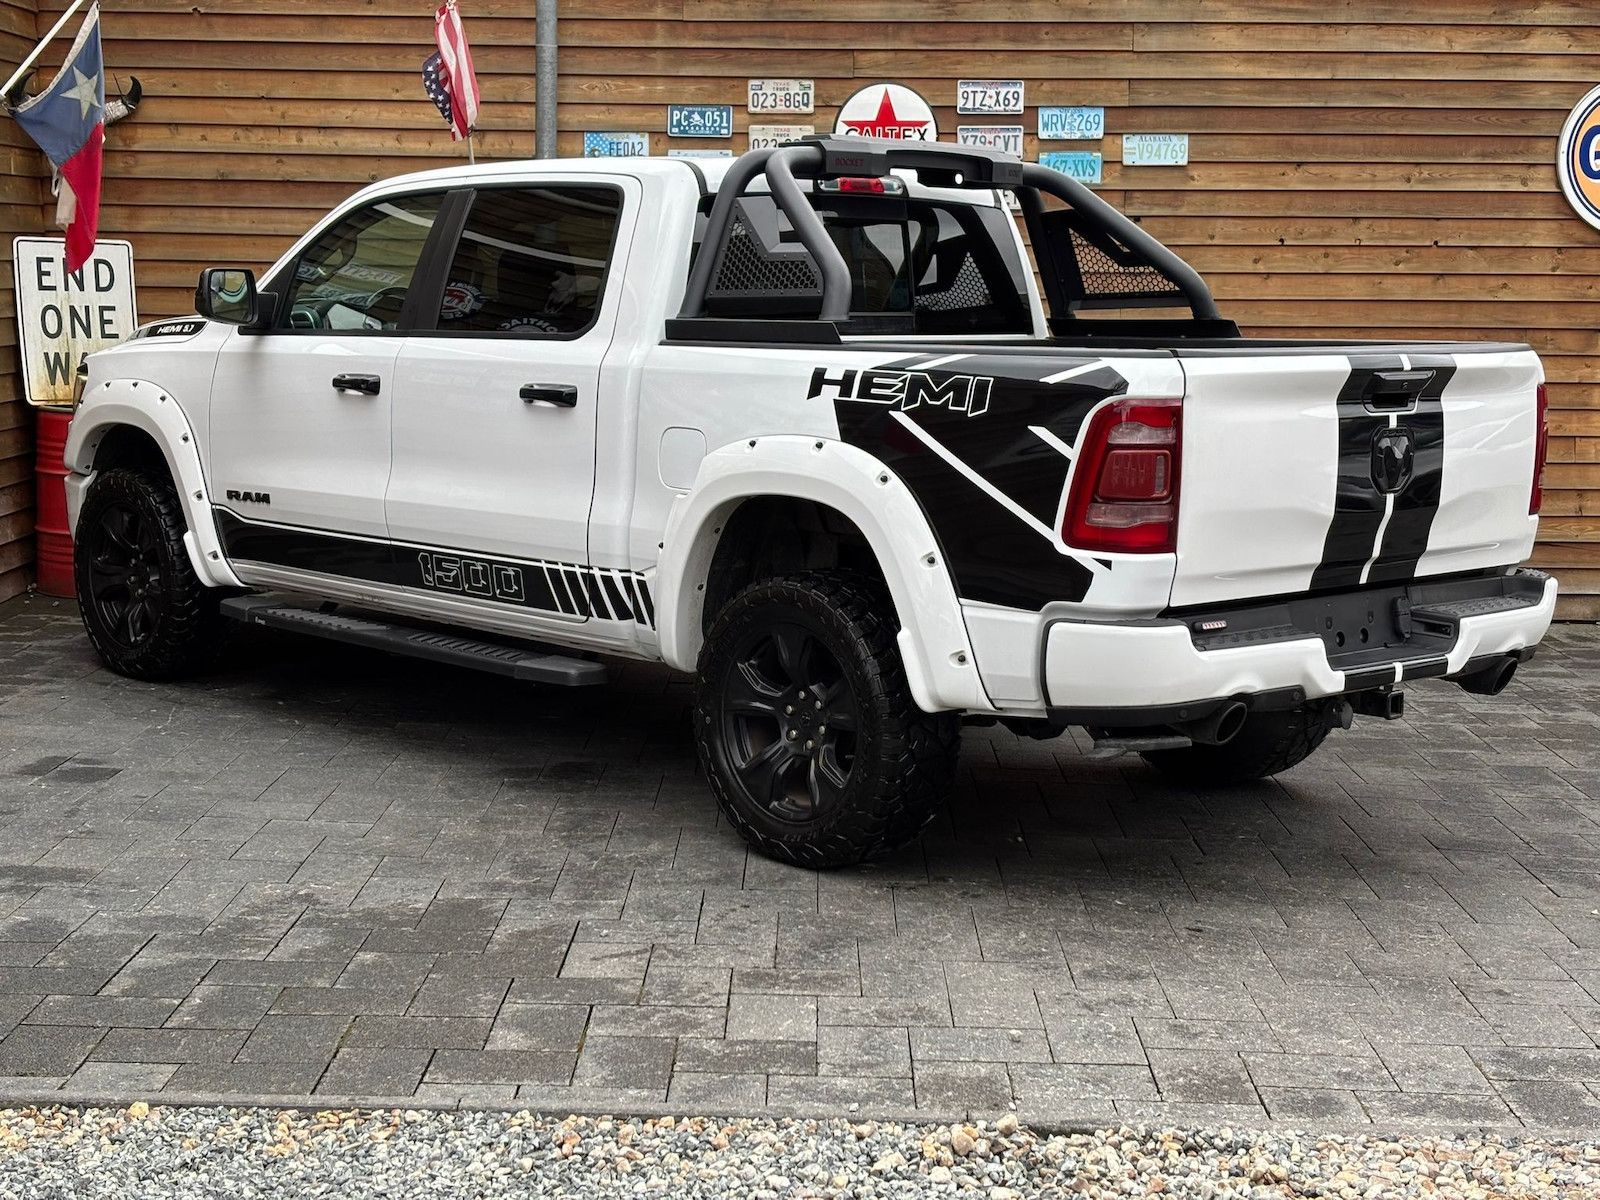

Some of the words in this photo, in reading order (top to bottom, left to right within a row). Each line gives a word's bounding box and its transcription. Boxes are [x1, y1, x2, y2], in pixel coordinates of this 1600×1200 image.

[35, 256, 115, 293] END
[40, 304, 120, 340] ONE
[156, 325, 184, 335] HEMI
[43, 351, 89, 386] W
[806, 366, 994, 418] HEMI
[226, 489, 271, 505] RAM
[417, 551, 526, 602] 1500
